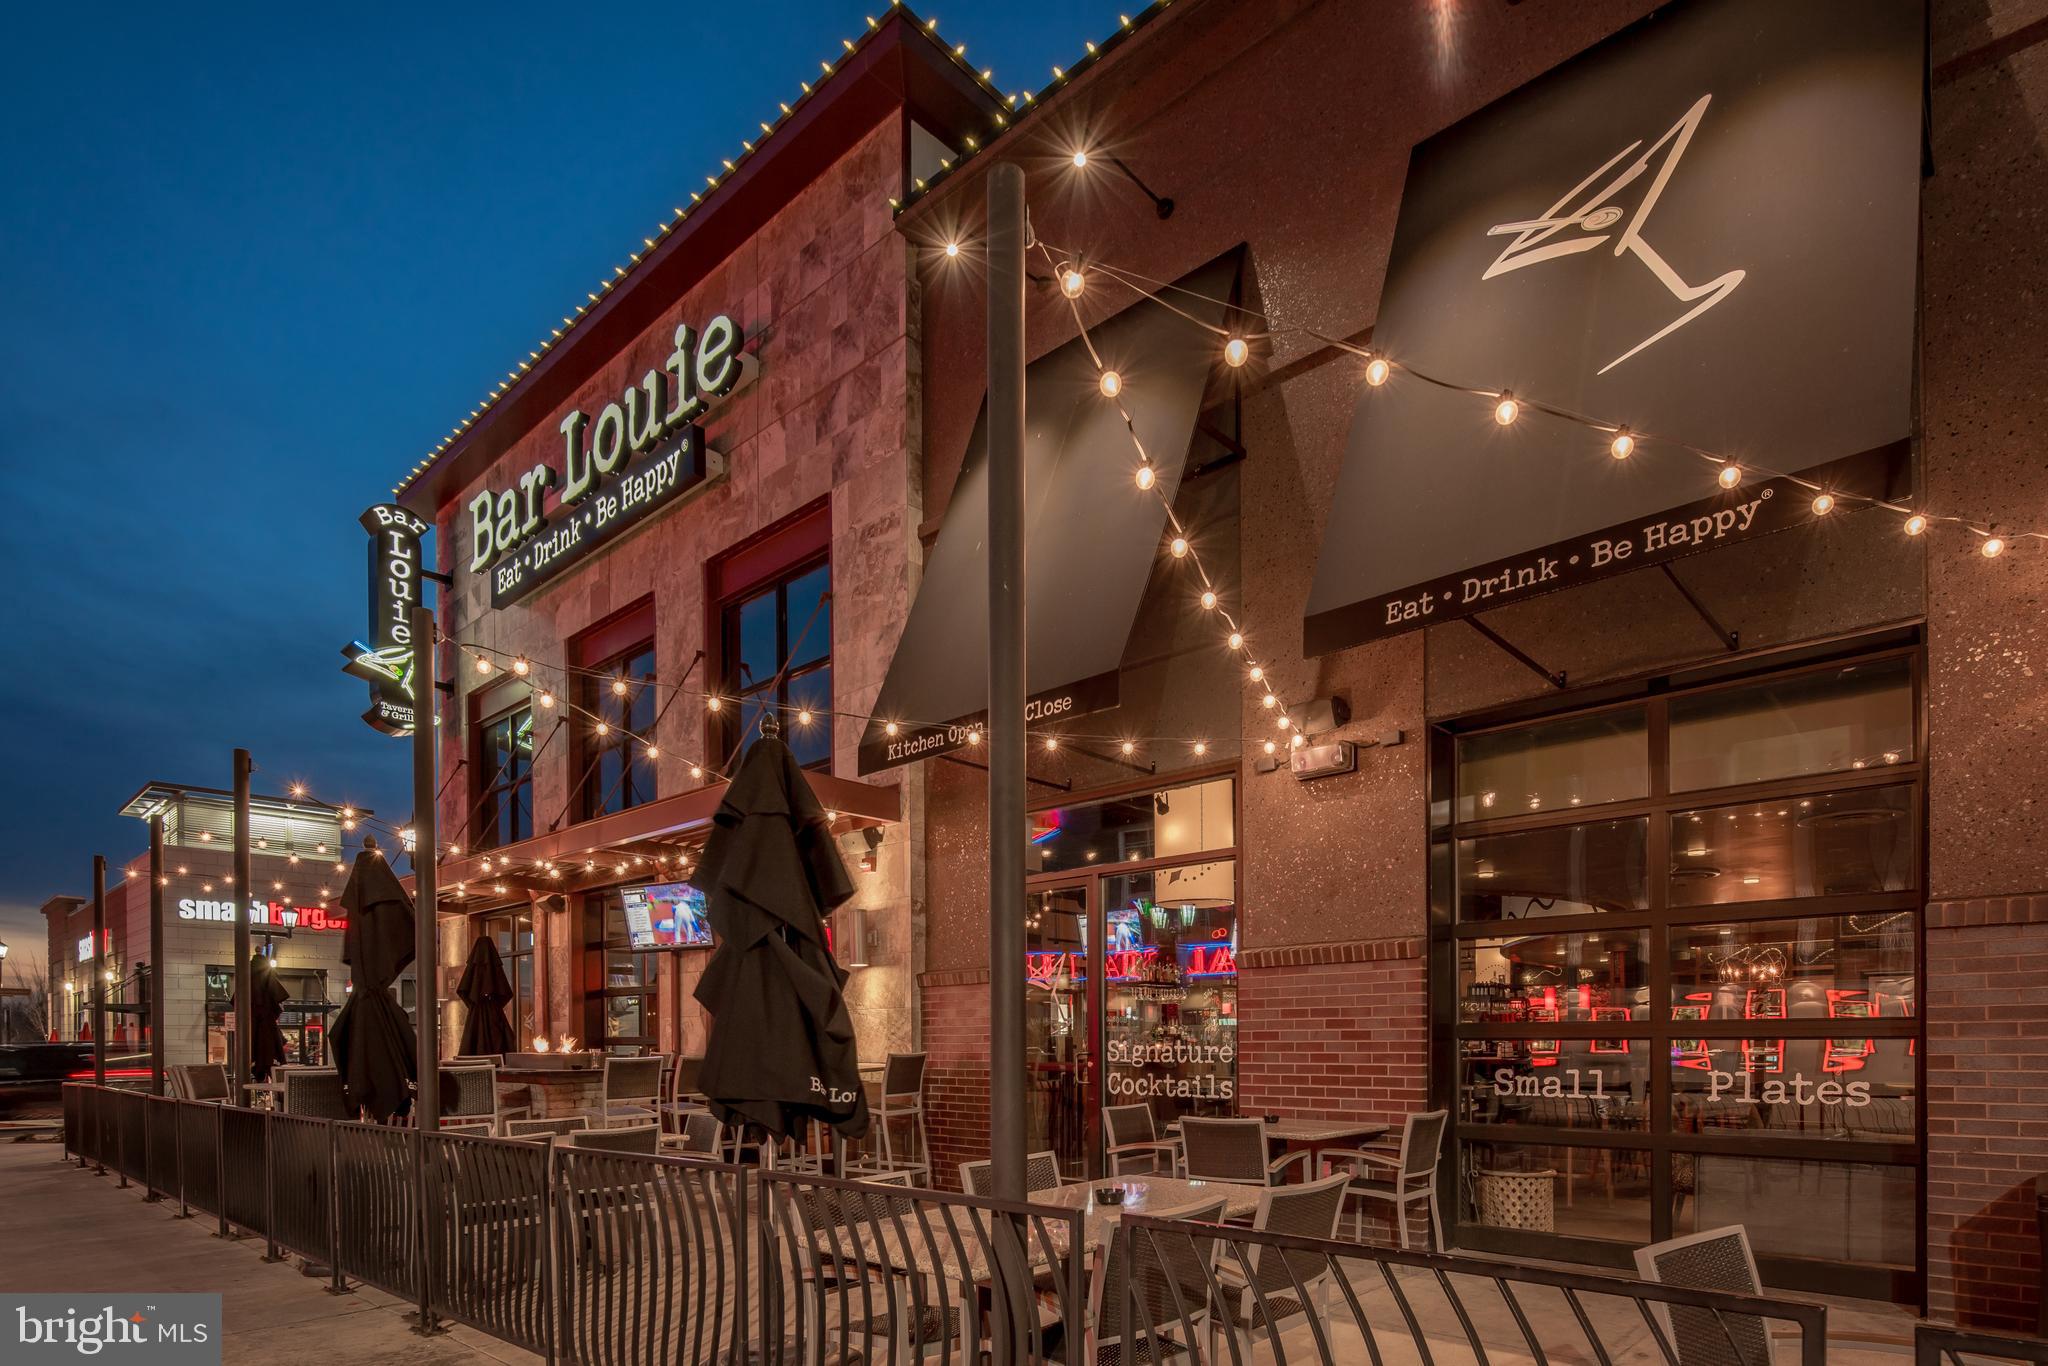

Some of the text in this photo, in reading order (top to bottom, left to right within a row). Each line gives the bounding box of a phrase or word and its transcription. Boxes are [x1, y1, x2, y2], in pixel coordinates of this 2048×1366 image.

[470, 315, 738, 573] Bar Louie
[373, 506, 427, 534] Bar
[497, 559, 522, 594] Eat
[534, 518, 582, 570] Drink
[596, 493, 617, 528] Be
[389, 531, 412, 644] Louie
[1385, 591, 1434, 626] Eat
[1462, 557, 1559, 604] Drink
[1591, 540, 1633, 568] Be
[887, 731, 945, 761] Kitchen
[1025, 696, 1072, 721] Close
[1107, 1039, 1234, 1068] Signature
[1107, 1072, 1234, 1100] Cocktails
[1494, 1068, 1872, 1107] Small Plates
